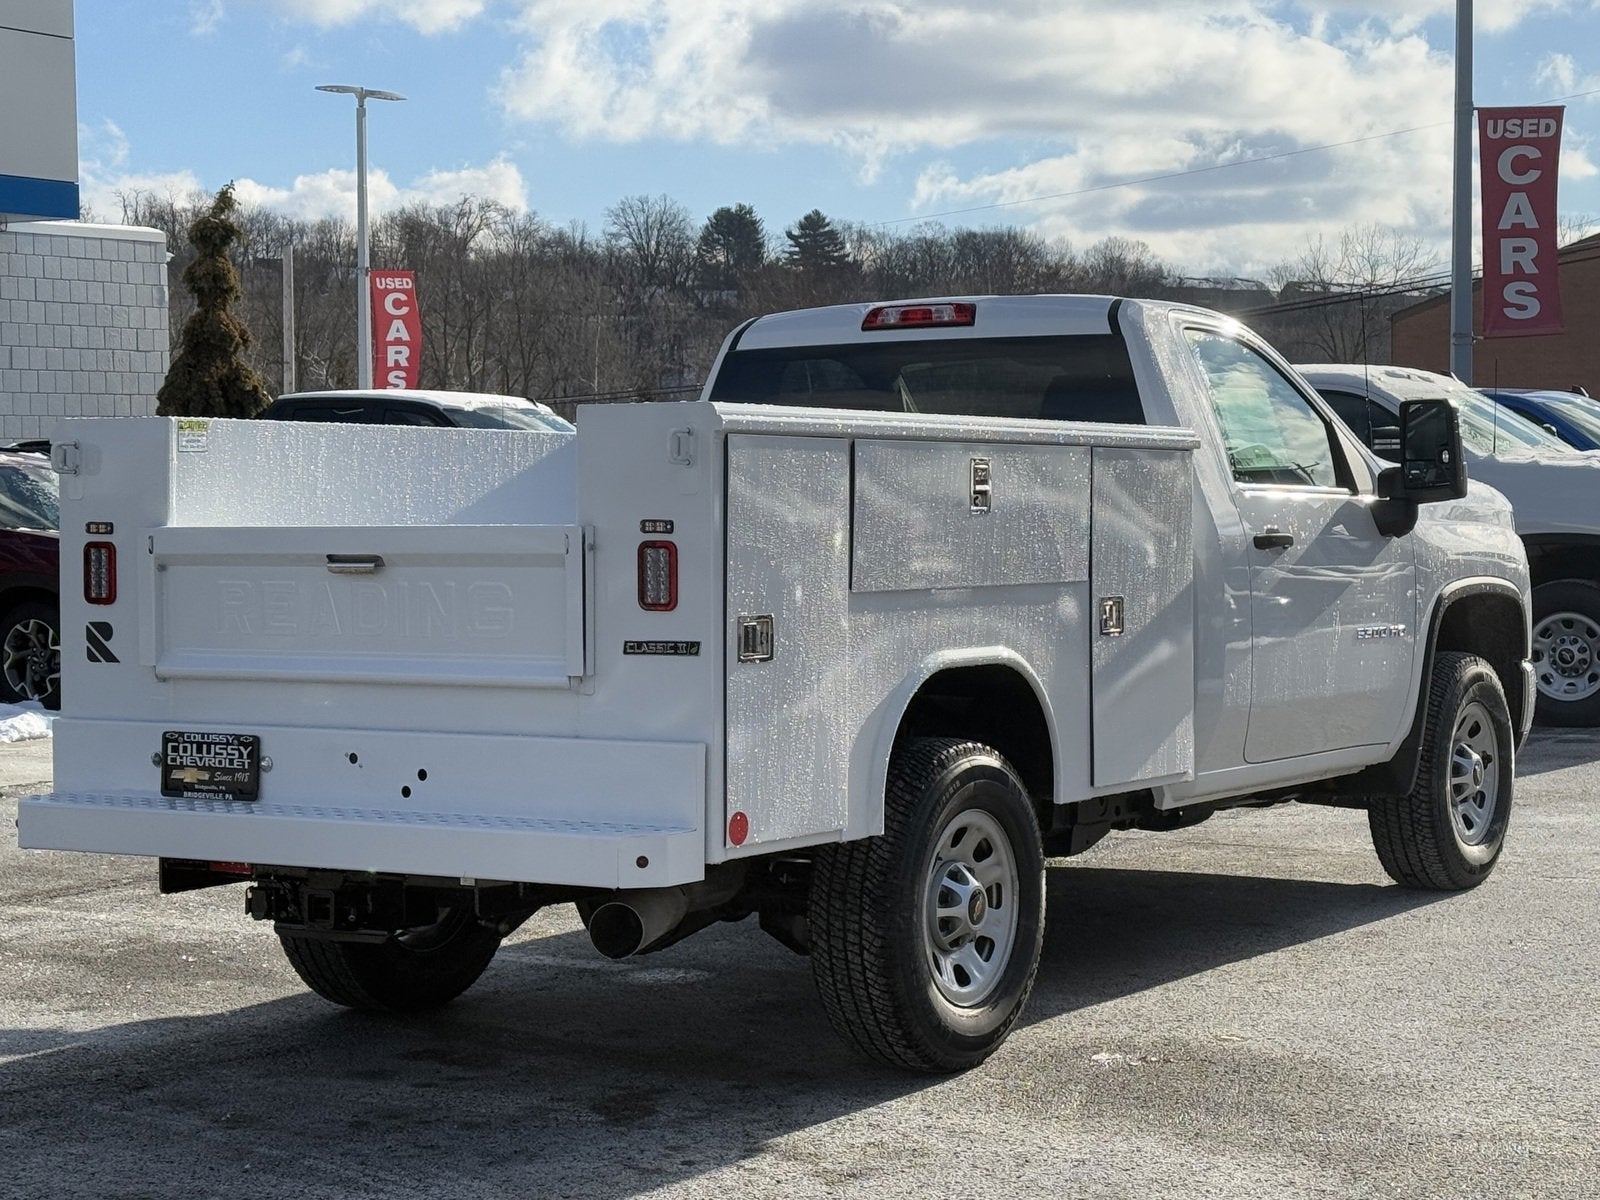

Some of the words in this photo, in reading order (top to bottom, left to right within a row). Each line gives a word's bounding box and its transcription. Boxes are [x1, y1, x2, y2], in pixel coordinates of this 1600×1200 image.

[1486, 118, 1557, 140] USED
[1497, 144, 1543, 320] CARS
[375, 277, 413, 289] USED
[384, 292, 411, 390] CARS
[216, 580, 515, 639] READING
[626, 642, 675, 654] CLASSIC
[677, 642, 687, 654] II
[184, 733, 235, 744] COLUSSY
[167, 742, 252, 759] COLUSSY
[167, 755, 251, 769] CHEVROLET
[214, 772, 232, 782] Since
[233, 772, 250, 783] 1918
